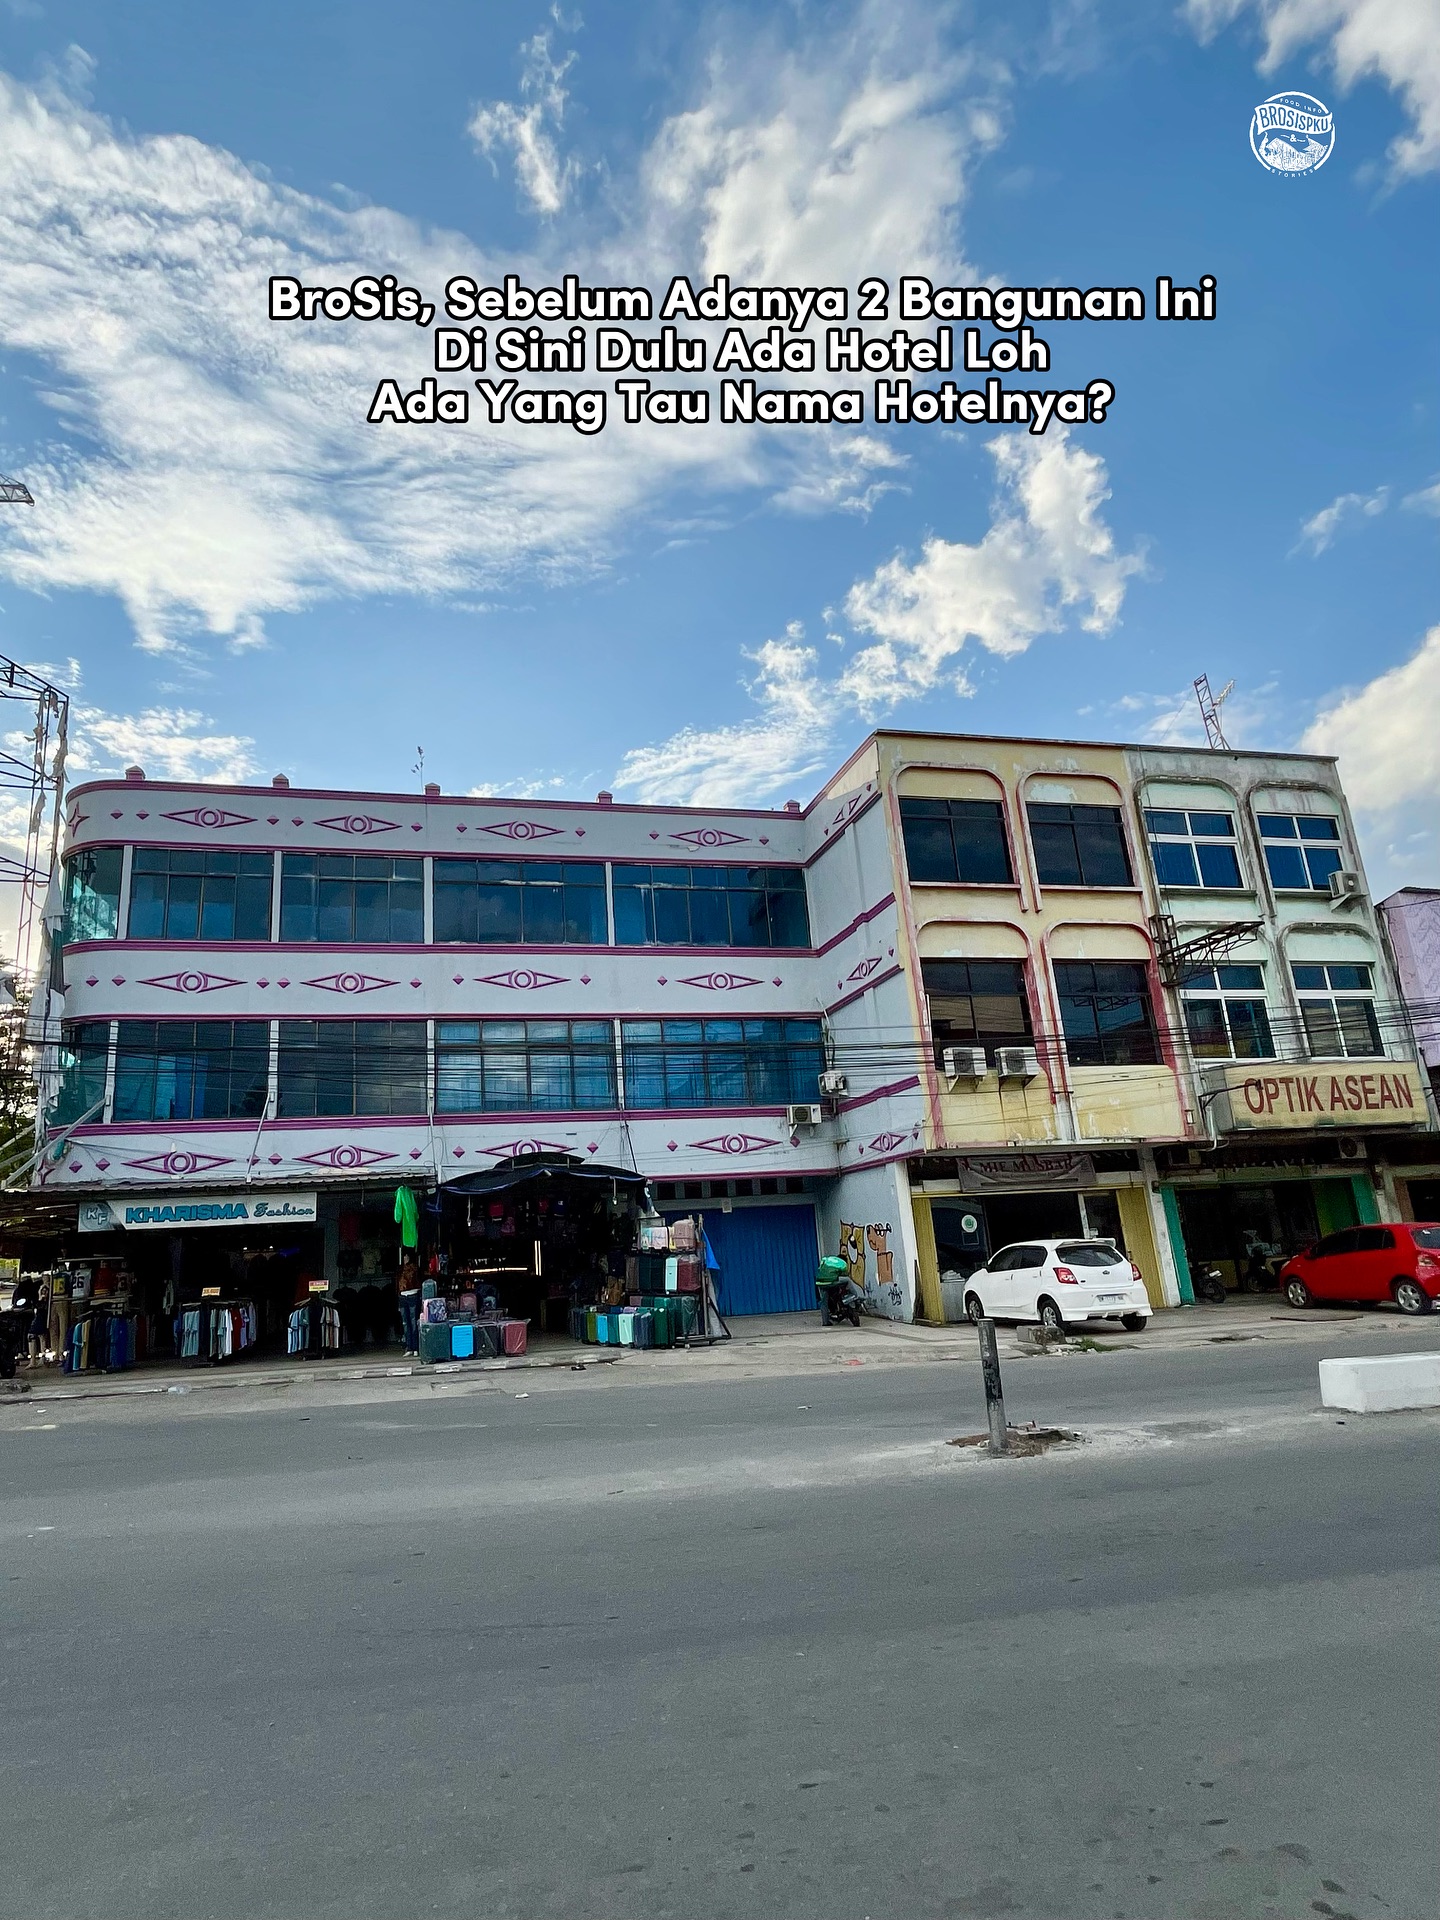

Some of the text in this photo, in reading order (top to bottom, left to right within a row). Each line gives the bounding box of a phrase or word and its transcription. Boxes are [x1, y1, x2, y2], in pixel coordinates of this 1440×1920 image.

[1244, 1074, 1413, 1114] OPTIK ASEAN
[126, 1203, 314, 1223] KHARISMA Fashion
